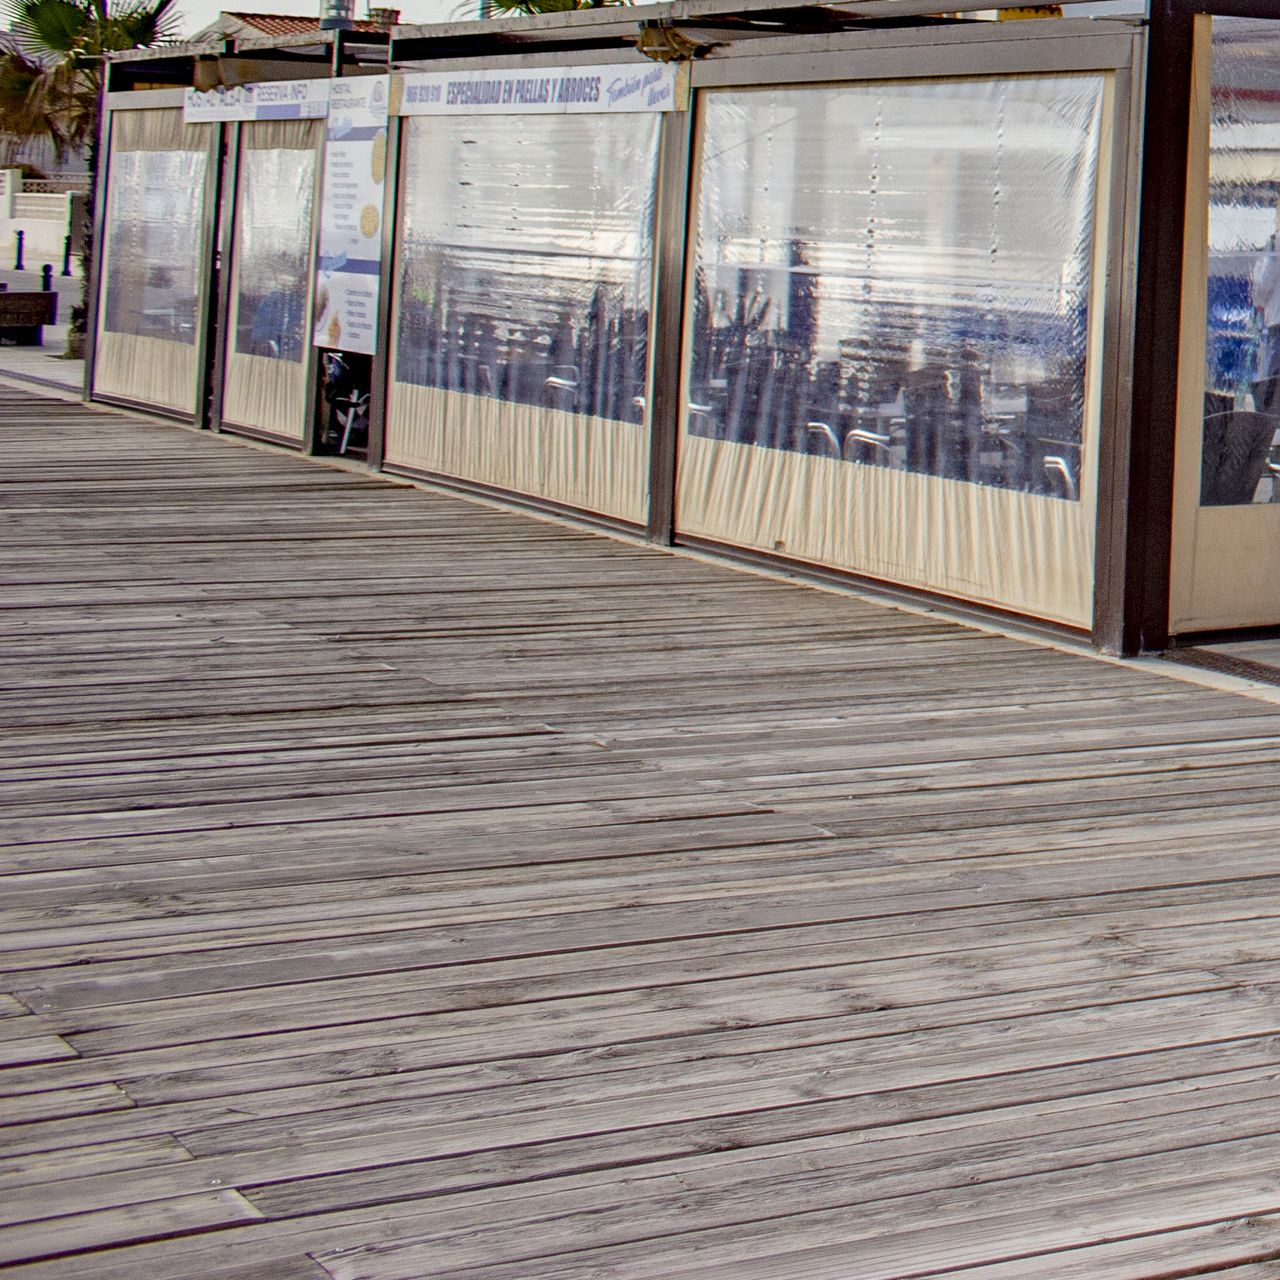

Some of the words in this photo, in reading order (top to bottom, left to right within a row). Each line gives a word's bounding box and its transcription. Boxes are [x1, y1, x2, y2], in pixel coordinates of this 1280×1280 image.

[446, 80, 501, 104] ESPECIALIDAD
[502, 80, 514, 103] EN
[514, 78, 550, 103] PAELLAS
[550, 77, 559, 102] Y
[556, 76, 601, 103] ARROCES
